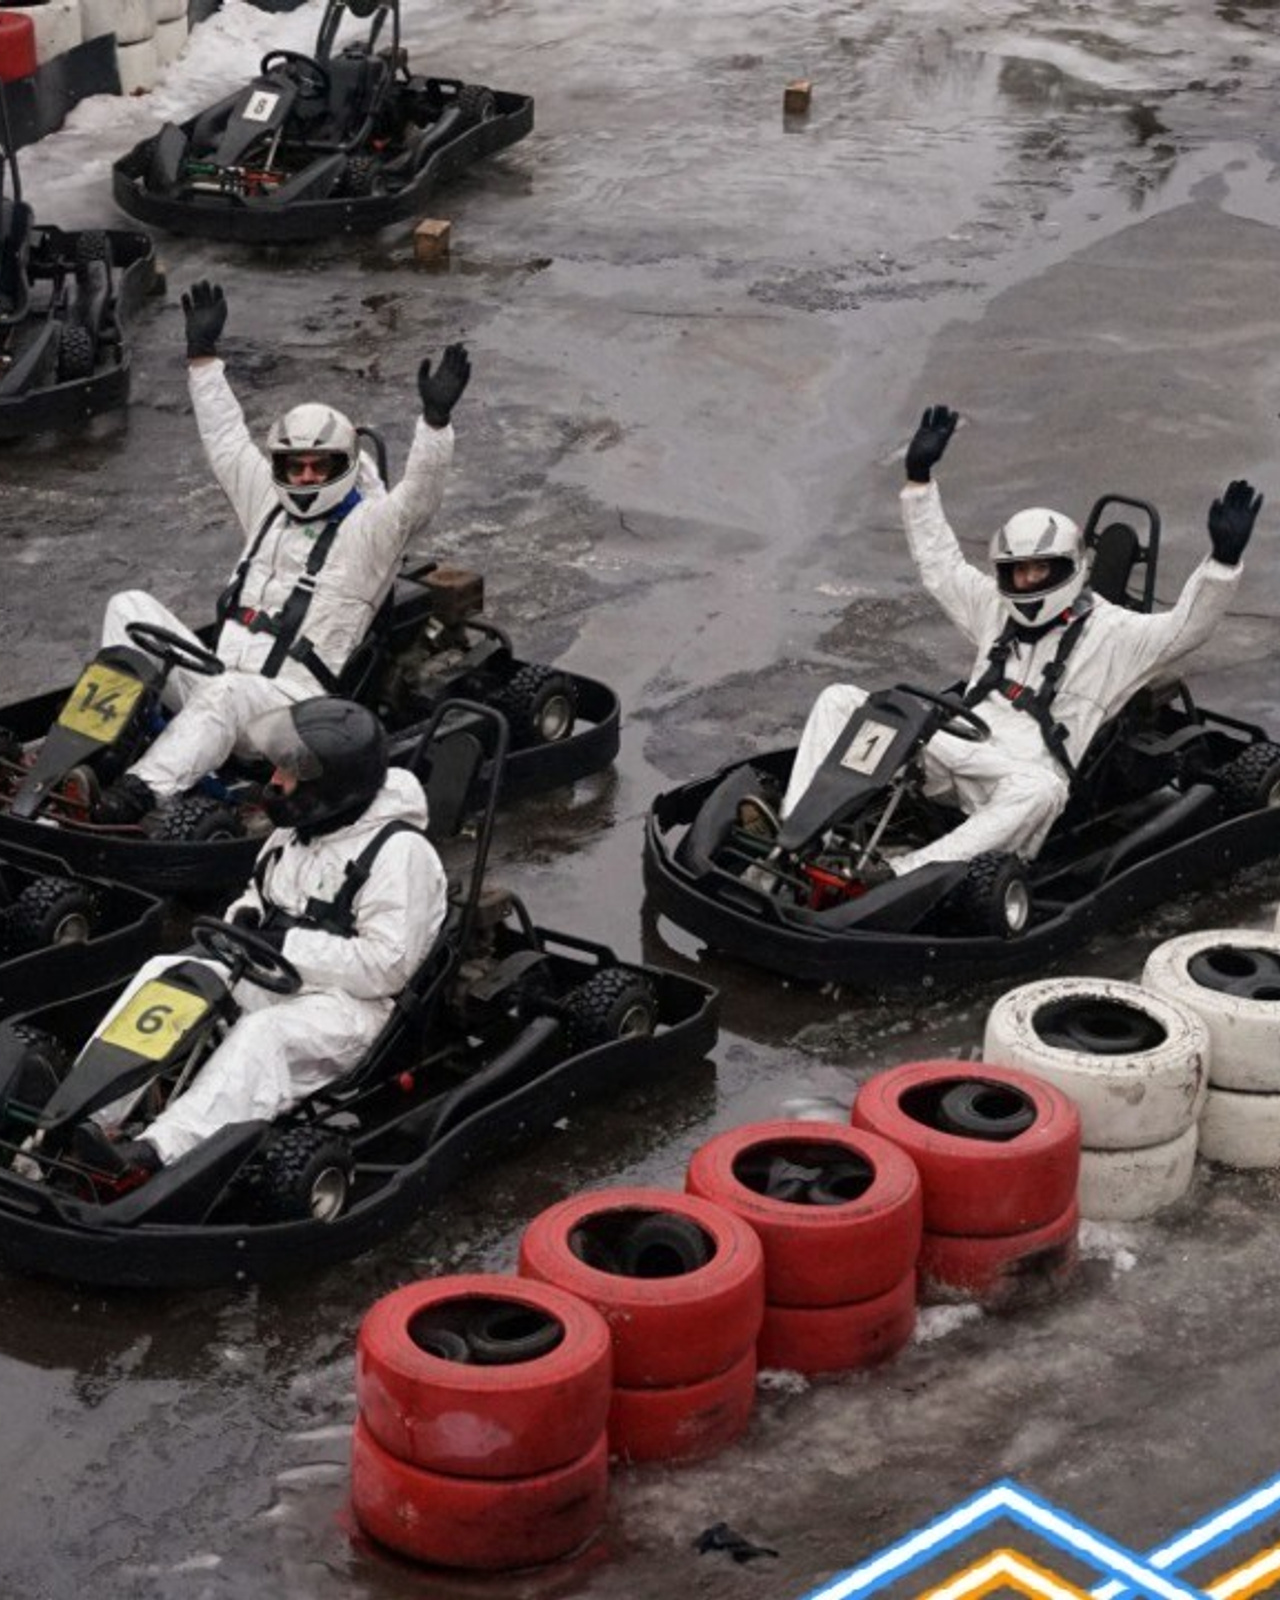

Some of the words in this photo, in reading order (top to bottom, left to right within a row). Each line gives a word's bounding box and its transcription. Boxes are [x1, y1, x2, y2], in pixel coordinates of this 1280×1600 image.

[79, 682, 122, 722] 14
[860, 735, 880, 762] 1
[136, 1004, 174, 1034] 6
